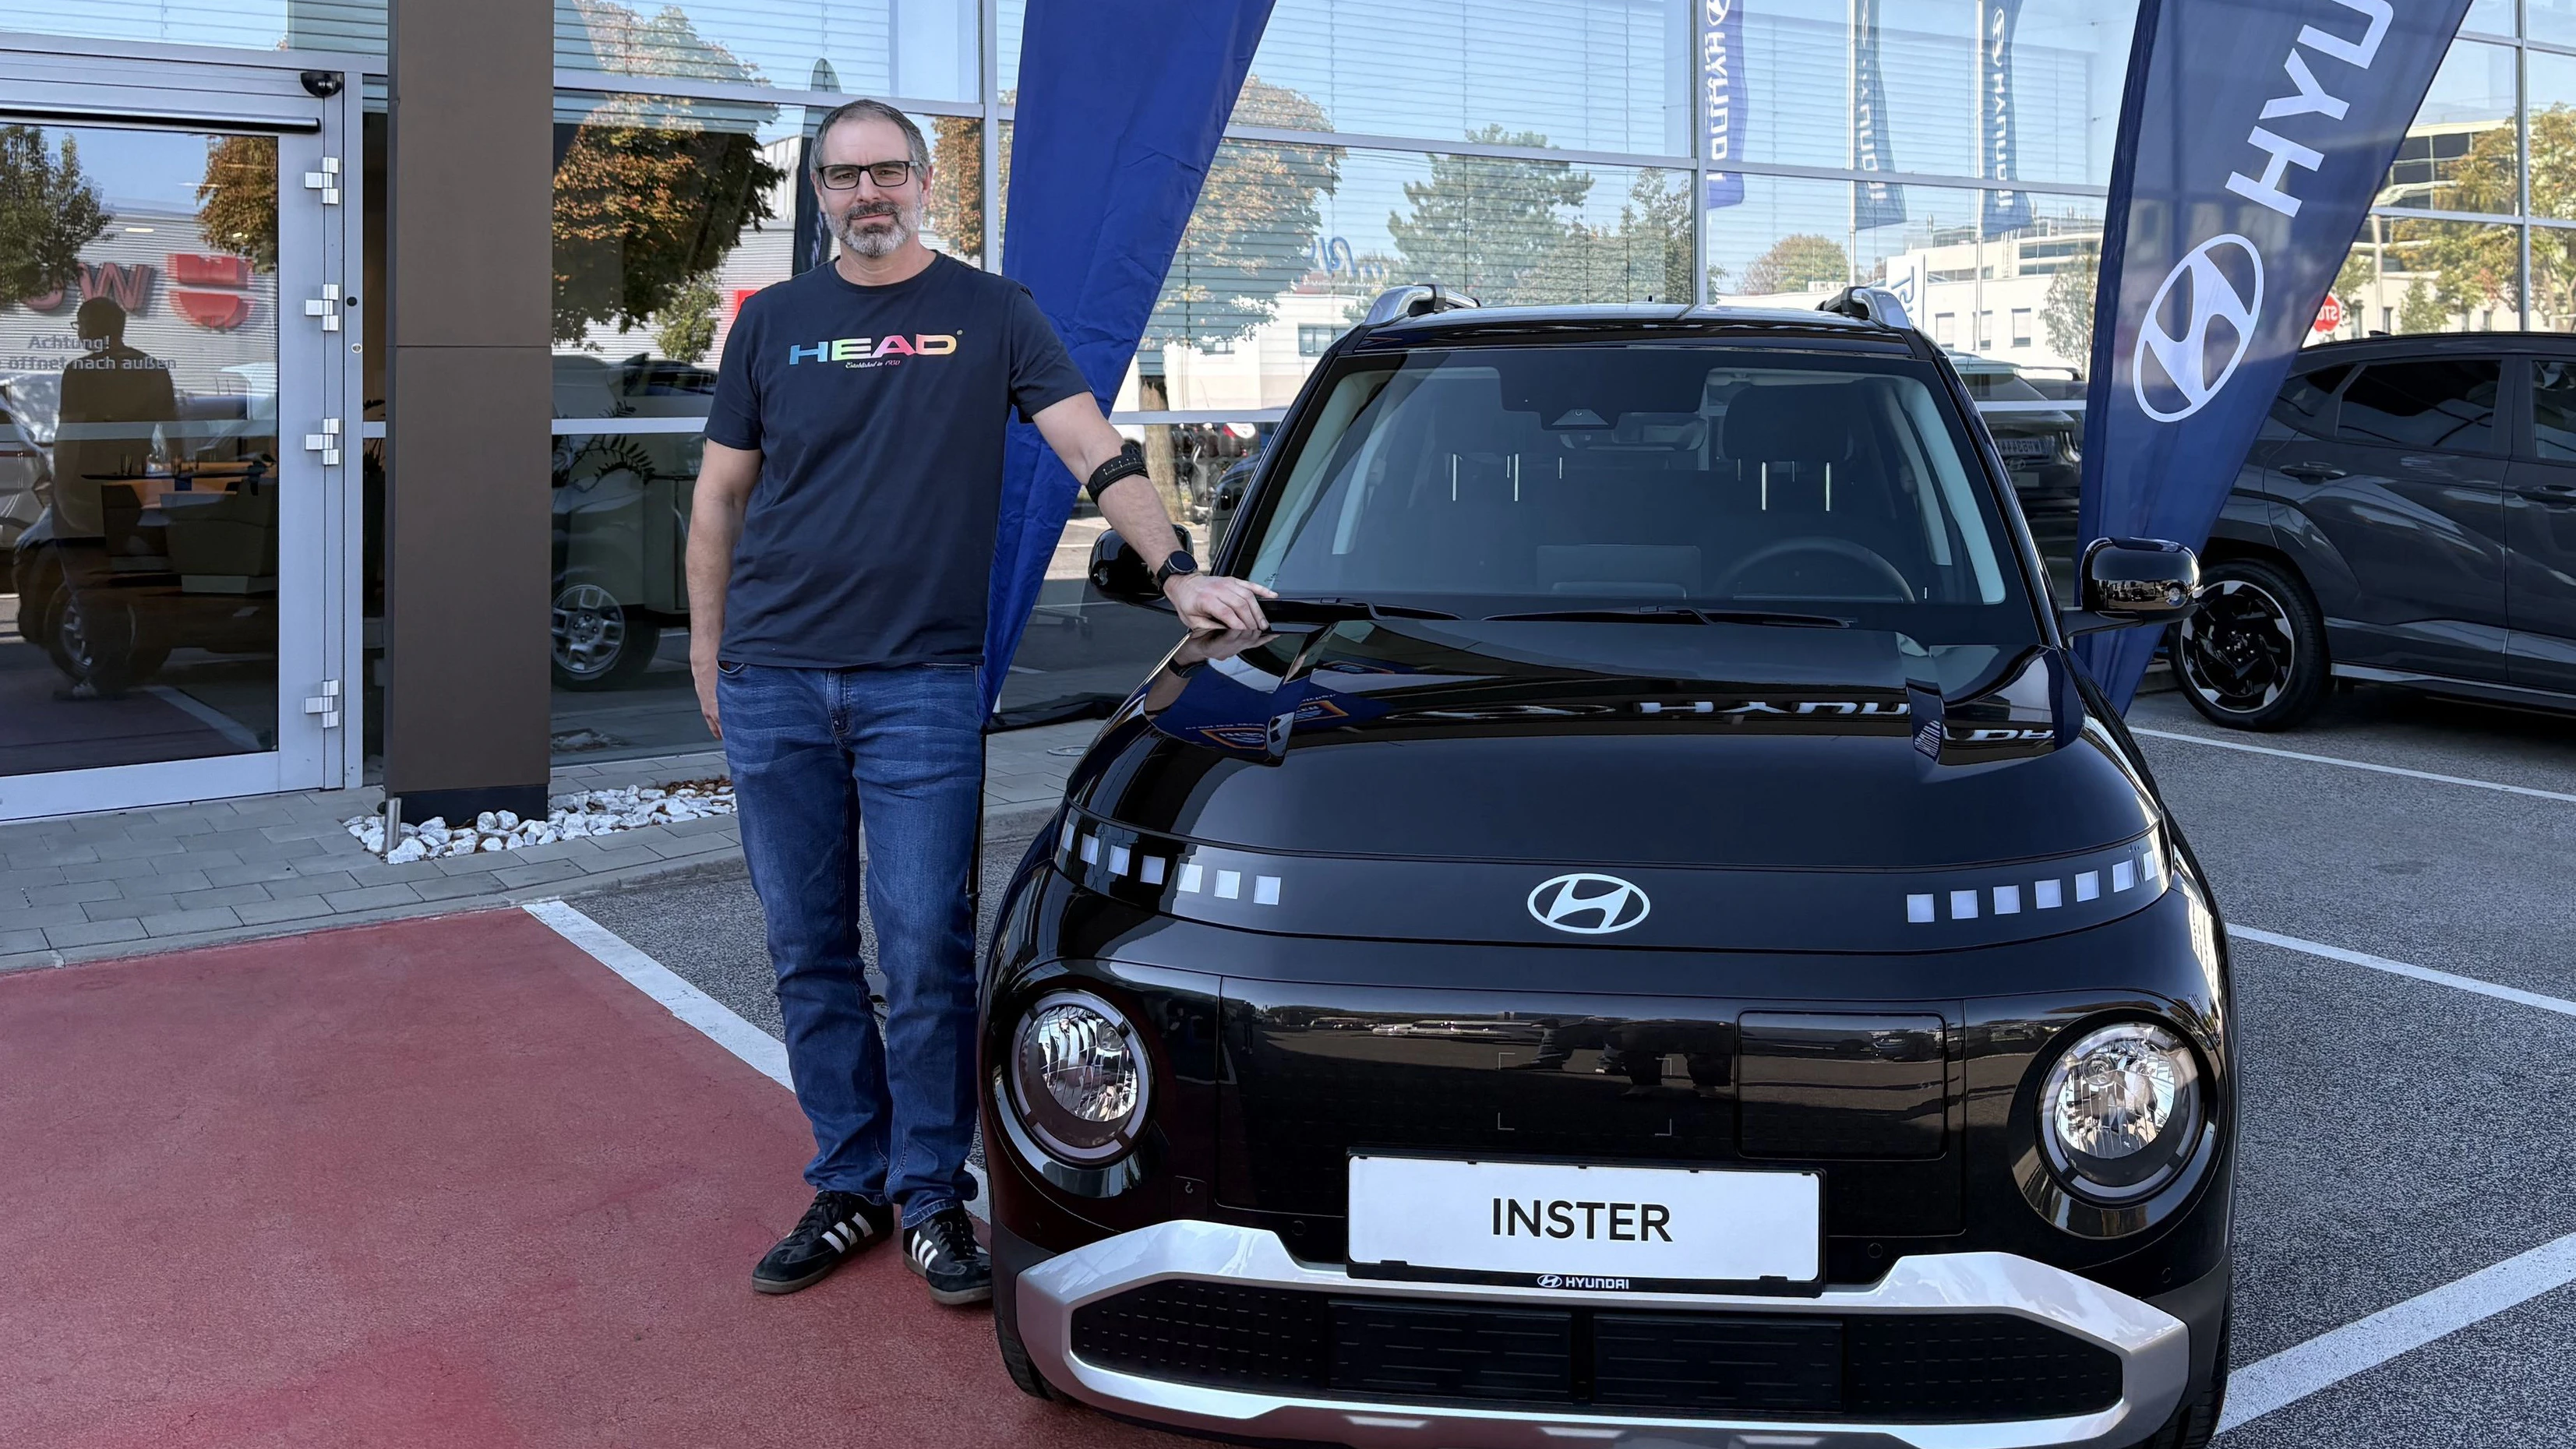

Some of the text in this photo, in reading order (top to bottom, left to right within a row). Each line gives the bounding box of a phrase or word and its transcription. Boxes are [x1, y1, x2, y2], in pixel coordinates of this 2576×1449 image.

[1705, 31, 1729, 181] HYUNDI
[28, 334, 110, 353] Achtung!
[789, 333, 957, 365] HEAD
[72, 356, 115, 369] nach
[122, 356, 176, 369] außen
[1493, 1198, 1673, 1242] INSTER
[1565, 1276, 1629, 1289] HYUNDAI
